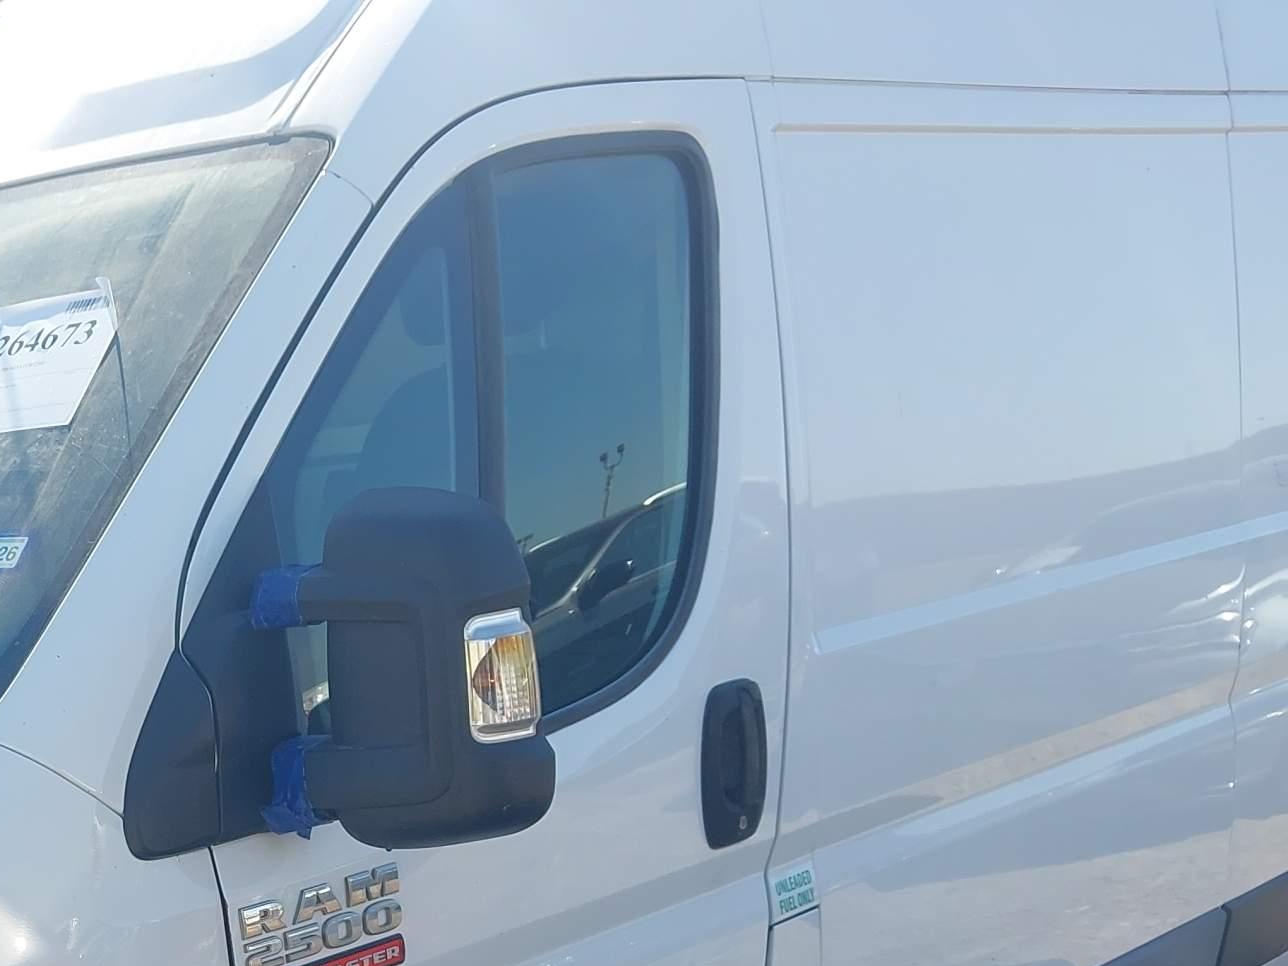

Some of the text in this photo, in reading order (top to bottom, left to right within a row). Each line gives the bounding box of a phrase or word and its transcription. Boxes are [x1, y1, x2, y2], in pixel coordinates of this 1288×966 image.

[774, 869, 812, 896] UNLEADED
[238, 862, 400, 940] RAM
[779, 887, 815, 915] FUEL ONLY
